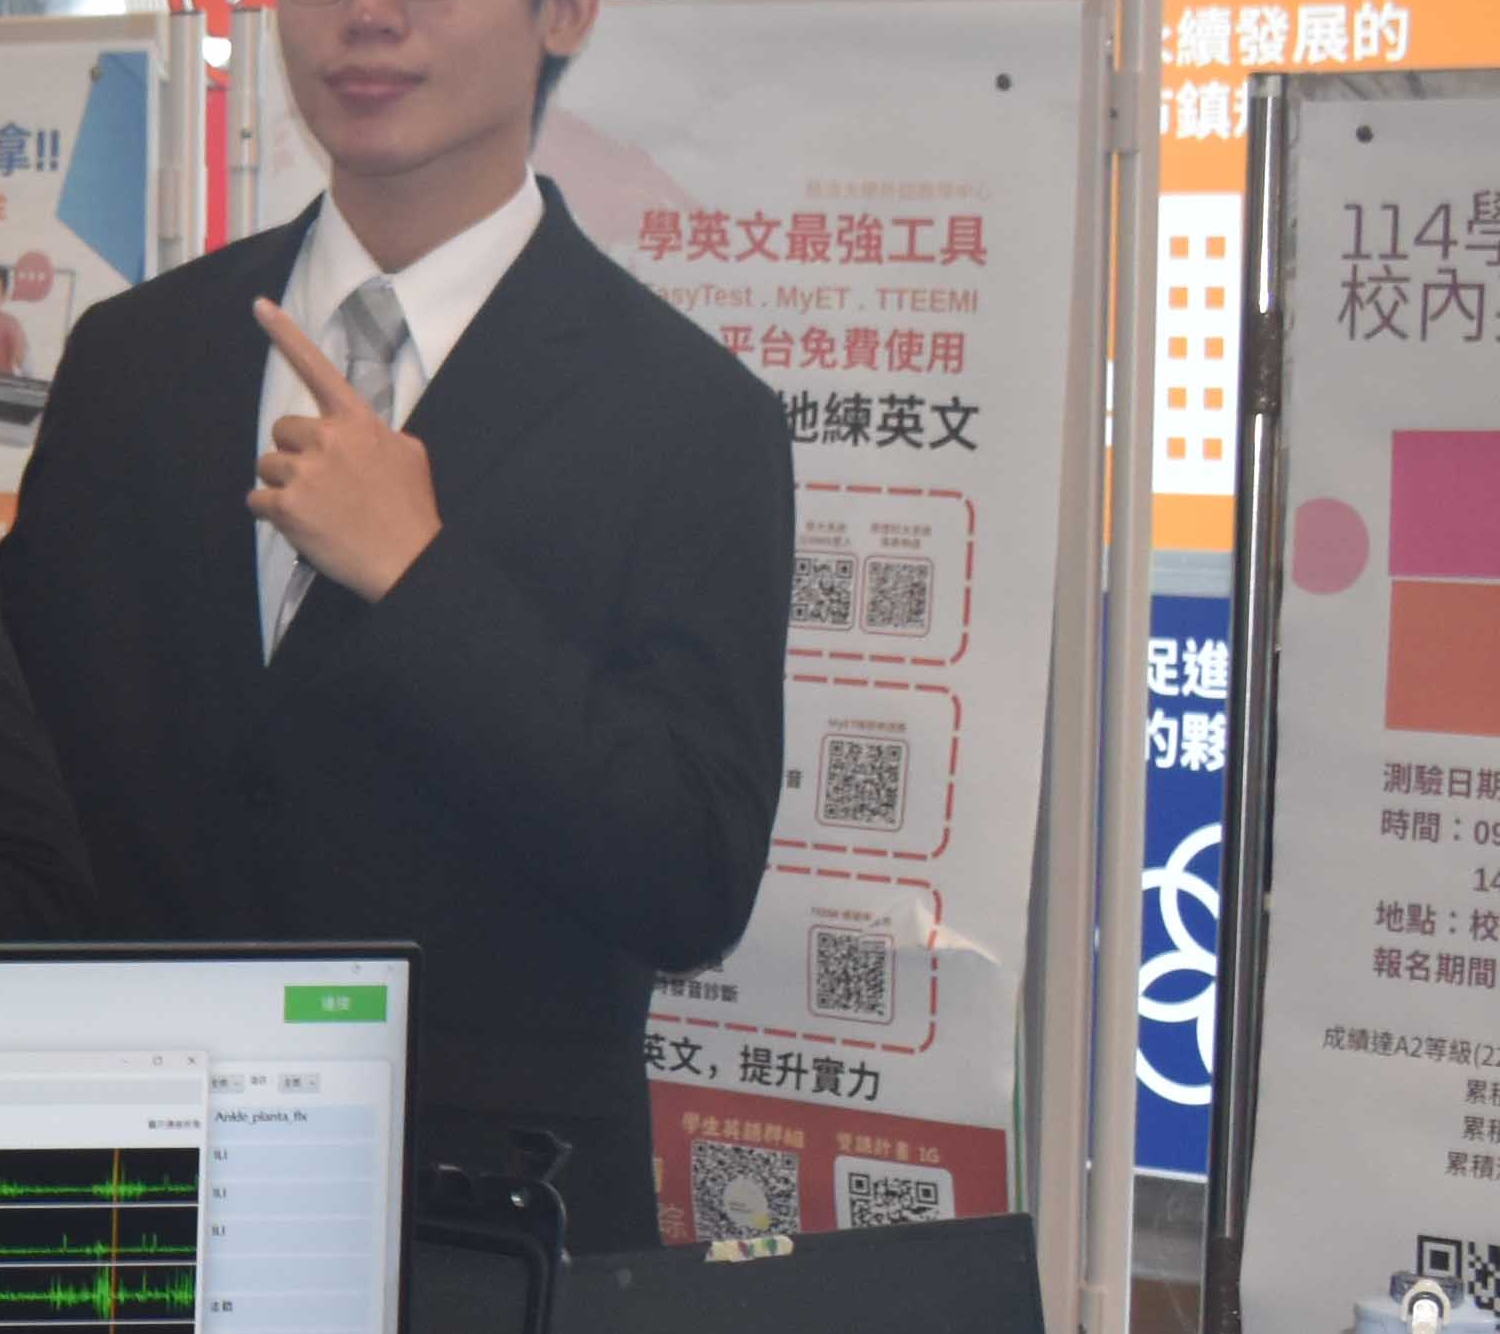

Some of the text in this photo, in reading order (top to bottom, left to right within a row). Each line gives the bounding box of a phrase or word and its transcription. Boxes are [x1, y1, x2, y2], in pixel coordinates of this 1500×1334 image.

[1161, 0, 1411, 67] 續發展的
[638, 210, 989, 267] 學英文最強工具
[776, 285, 850, 314] MyET
[876, 287, 979, 315] TTEEMI
[1338, 262, 1500, 343] 校內
[719, 325, 967, 375] 平台免費使用
[1383, 763, 1500, 800] 測驗日期
[1372, 947, 1498, 990] 報名期間
